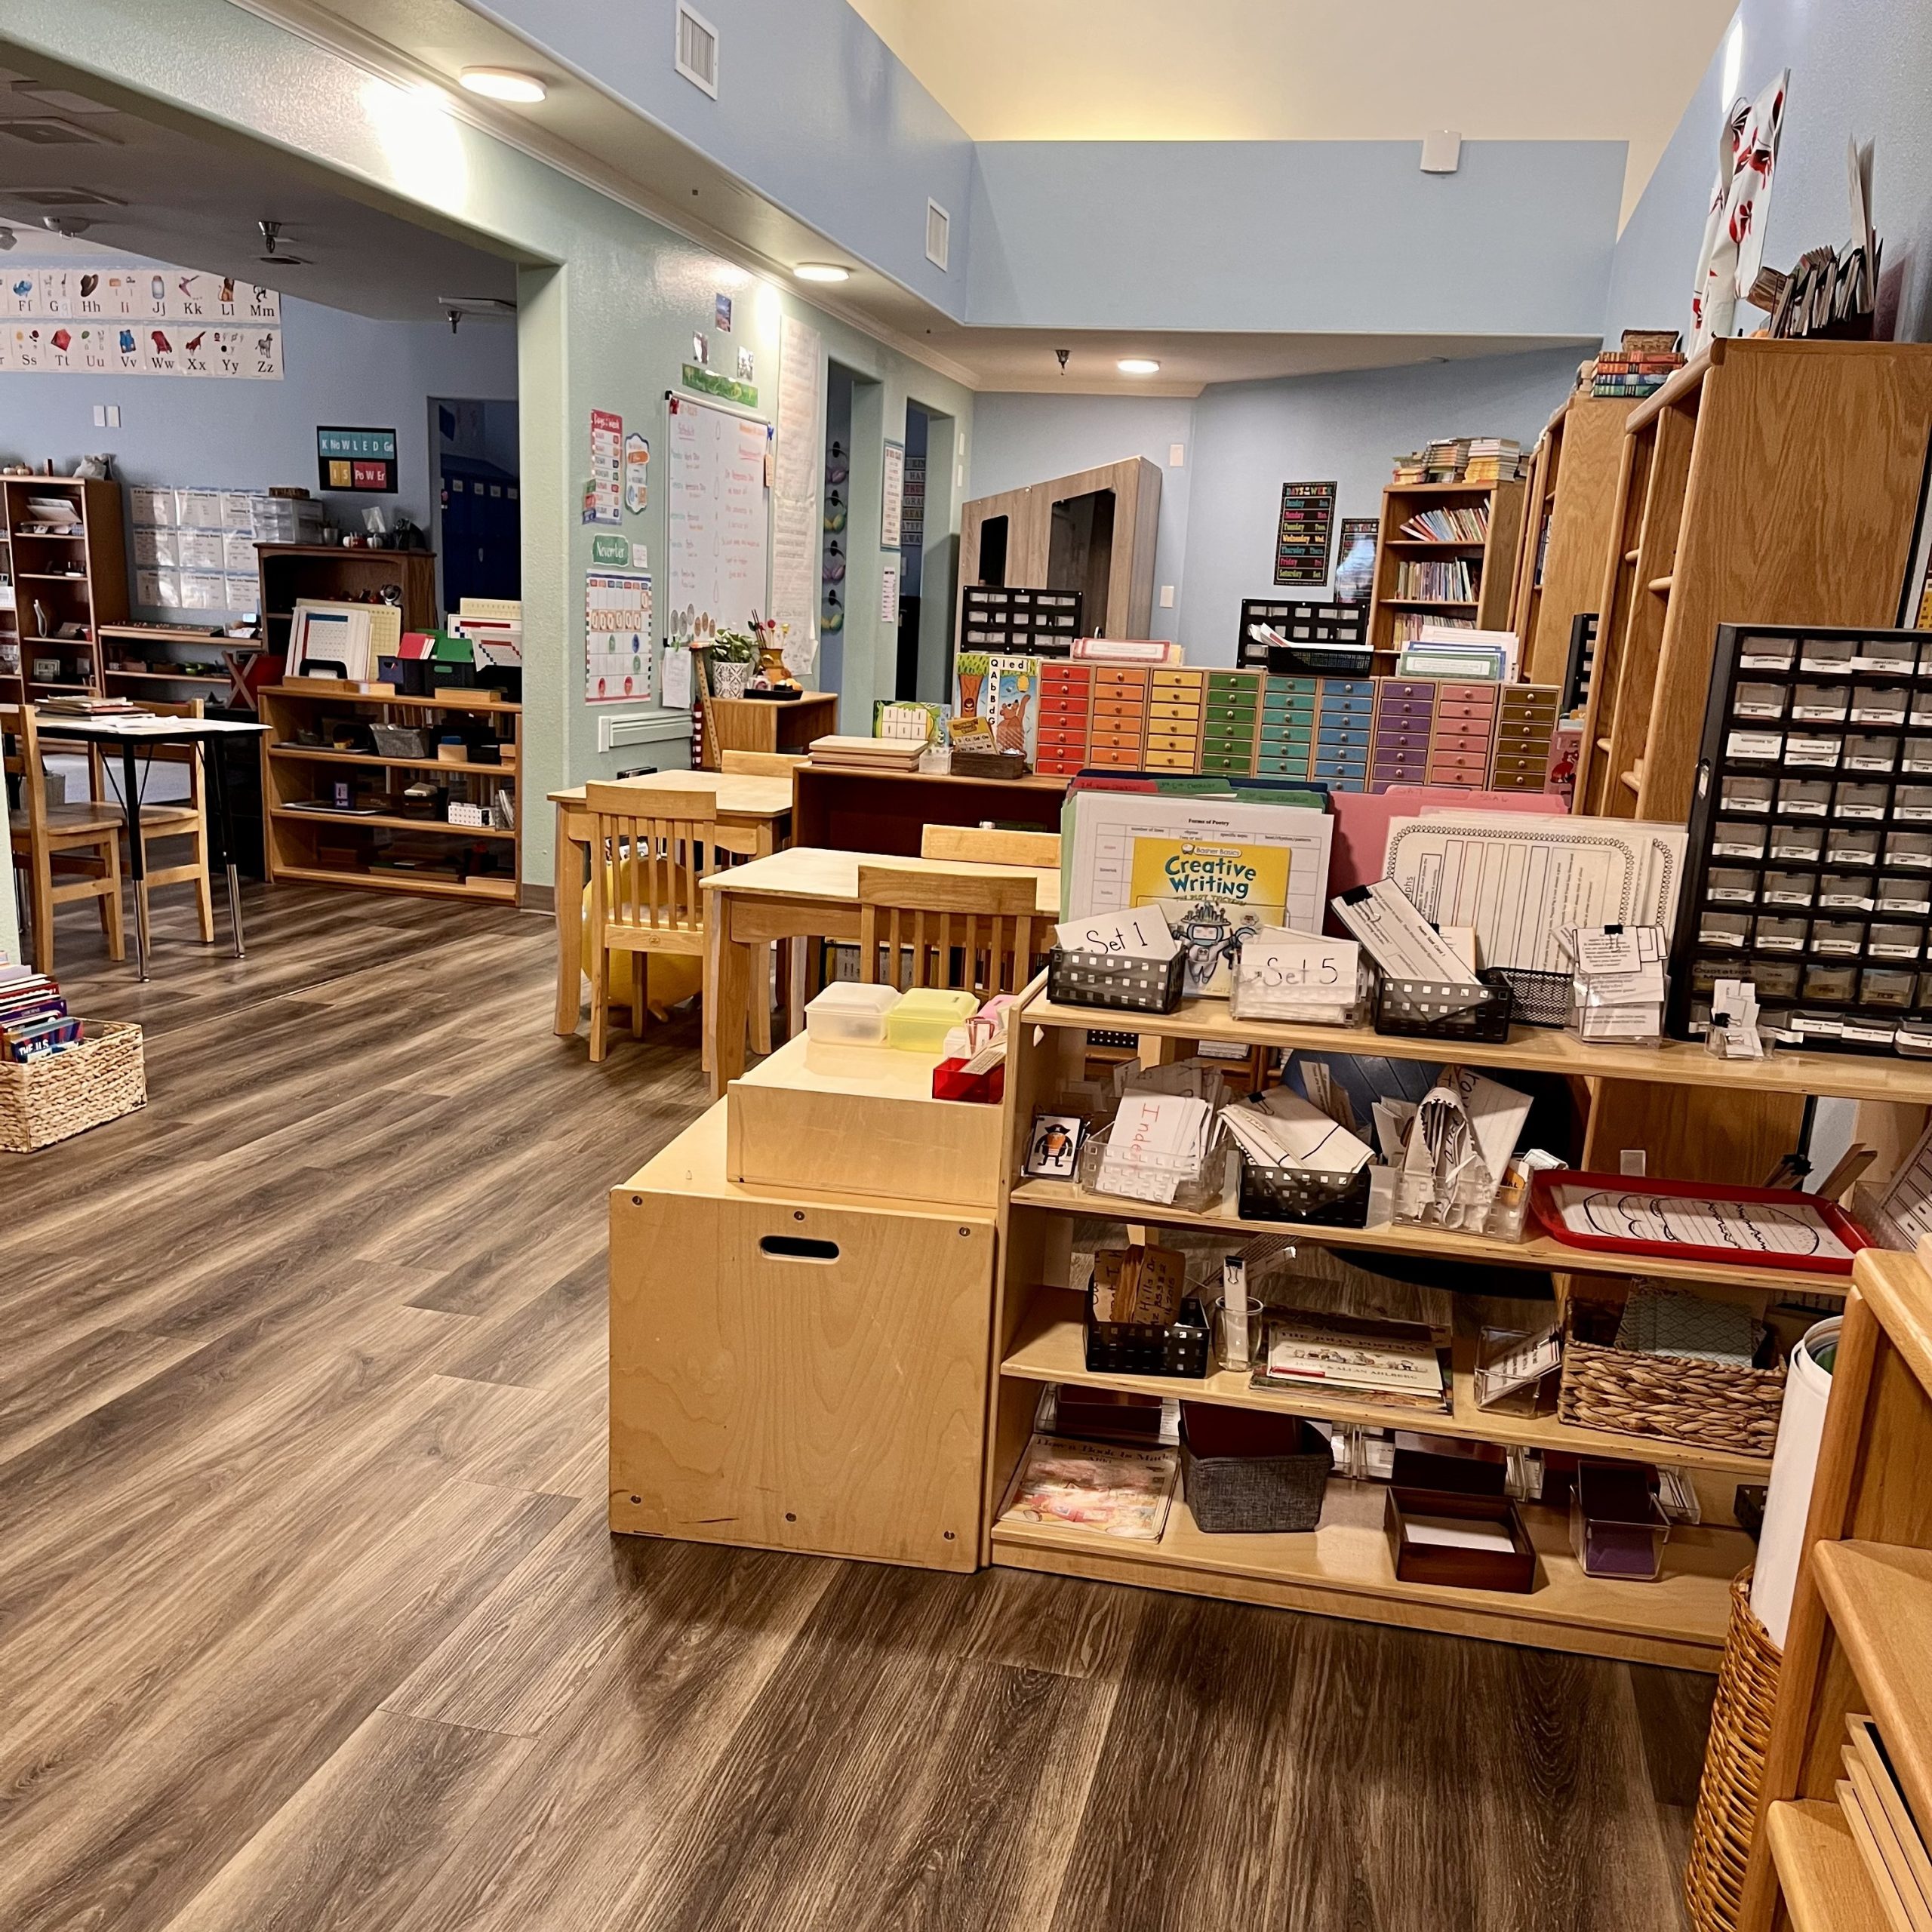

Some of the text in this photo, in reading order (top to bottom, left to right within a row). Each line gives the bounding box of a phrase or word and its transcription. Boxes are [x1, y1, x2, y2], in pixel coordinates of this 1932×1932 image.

[19, 302, 32, 312] Ff
[82, 302, 100, 312] Hh
[152, 302, 166, 316] Jj
[183, 303, 202, 315] Kk
[221, 304, 234, 315] Ll
[251, 305, 275, 317] Mm
[22, 355, 274, 374] Ss Tt Uu Vv Ww Xx Yy Zz
[1287, 487, 1304, 495] DAYS
[1311, 487, 1332, 495] WEEK
[1286, 500, 1305, 508] Sunday
[1285, 512, 1304, 520] Monday
[1284, 523, 1304, 532] Tuesday
[1283, 534, 1310, 544] Wednesday
[597, 542, 624, 558] November
[1281, 546, 1306, 555] Thursday
[1281, 558, 1298, 567] Friday
[1279, 570, 1303, 579] Saturday
[1164, 856, 1257, 881] Creative
[1087, 928, 1125, 955] Set
[1433, 943, 1443, 955] Card
[1263, 957, 1338, 987] Set 5
[1315, 1335, 1352, 1344] JOLLY
[1358, 1340, 1426, 1352] POSTMAN
[1082, 1445, 1115, 1457] Book
[1137, 1453, 1173, 1462] Made
